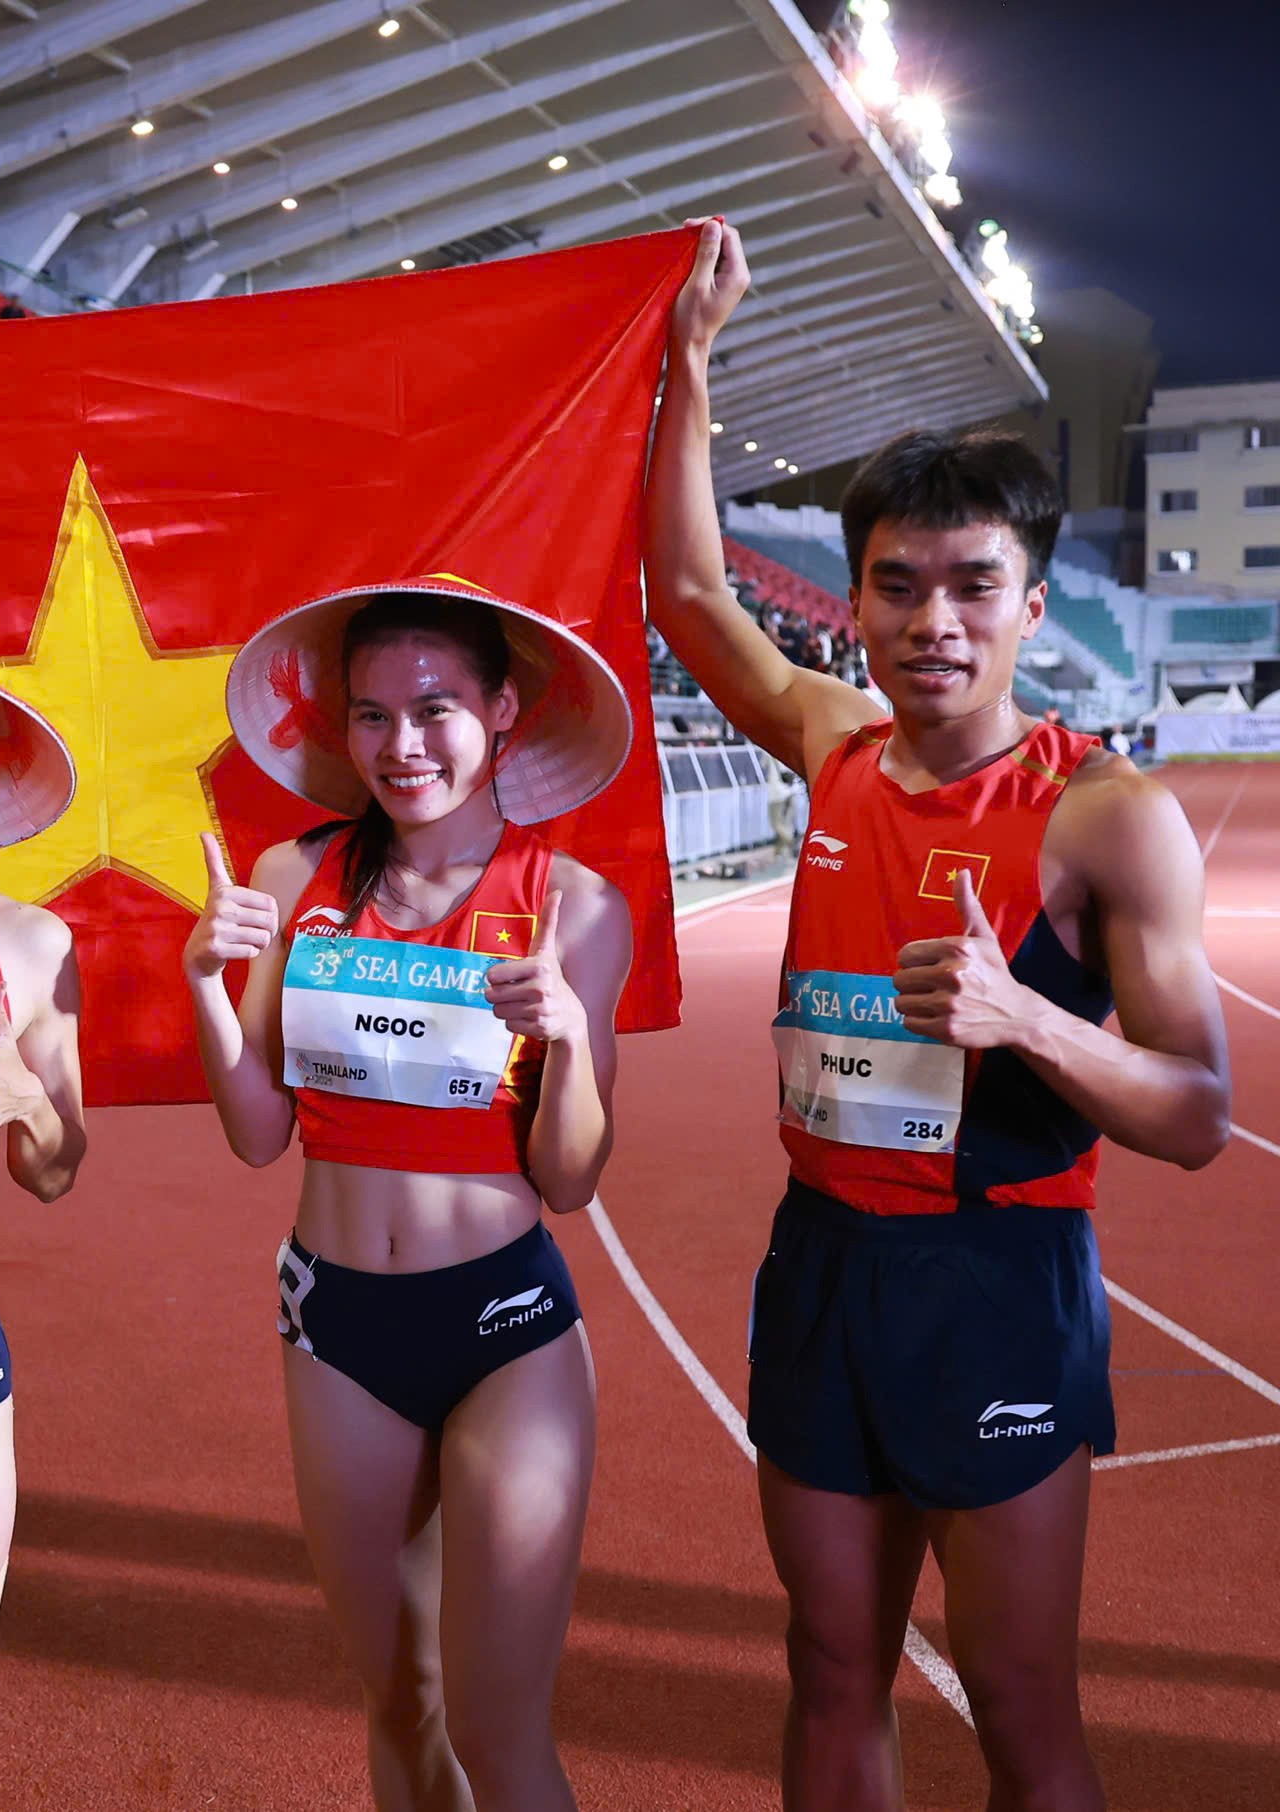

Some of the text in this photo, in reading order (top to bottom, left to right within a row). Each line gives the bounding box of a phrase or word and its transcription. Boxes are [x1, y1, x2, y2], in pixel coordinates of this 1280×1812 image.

[310, 946, 354, 978] 33rd
[353, 954, 399, 984] SEA
[811, 989, 842, 1019] SEA
[355, 1013, 426, 1038] NGOC
[312, 1062, 368, 1081] THAILAND
[821, 1053, 872, 1078] PHUC
[449, 1079, 482, 1096] 651
[903, 1121, 943, 1140] 284
[480, 1298, 553, 1335] LI-NING
[979, 1421, 1055, 1439] LI-NING
